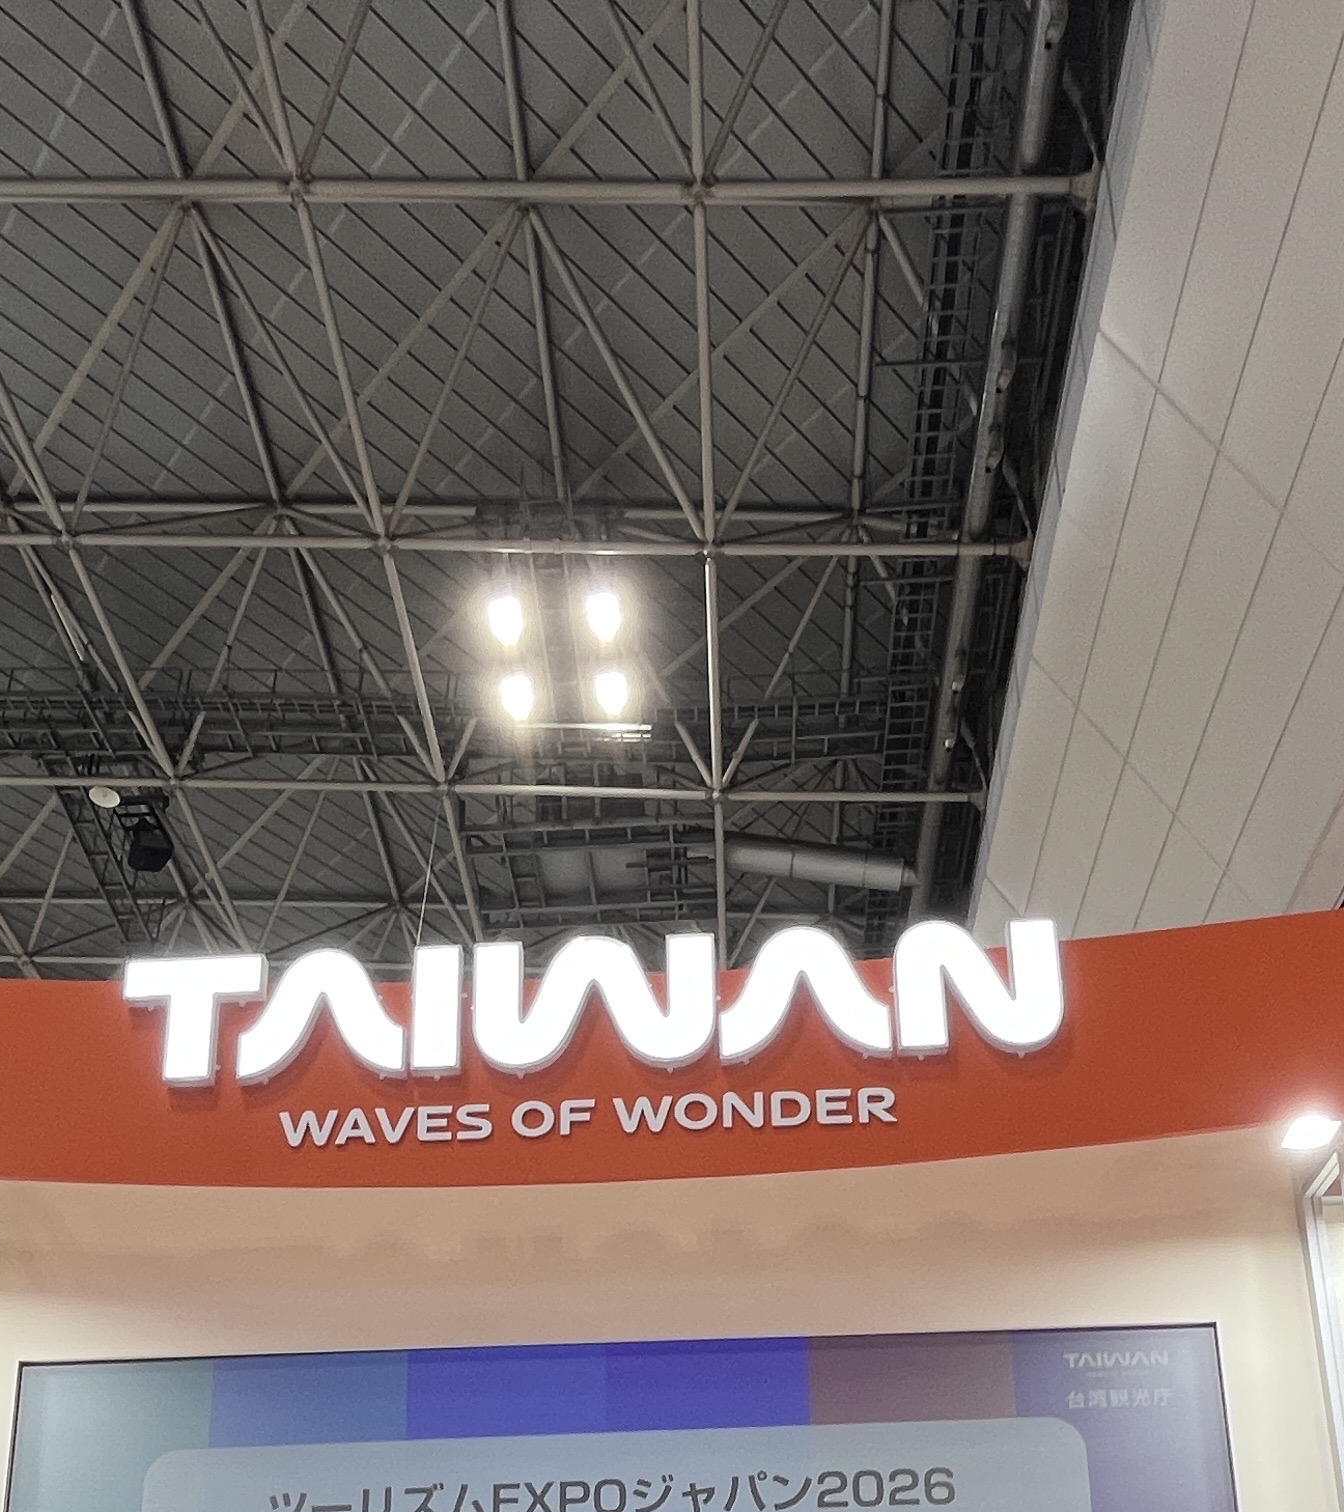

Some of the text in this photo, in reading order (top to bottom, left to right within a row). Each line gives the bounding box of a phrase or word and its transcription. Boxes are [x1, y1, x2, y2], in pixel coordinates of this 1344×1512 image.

[123, 919, 1063, 1085] TAIWAN
[279, 1087, 898, 1147] WAVES OF WONDER
[1063, 1350, 1169, 1369] TAIWAN
